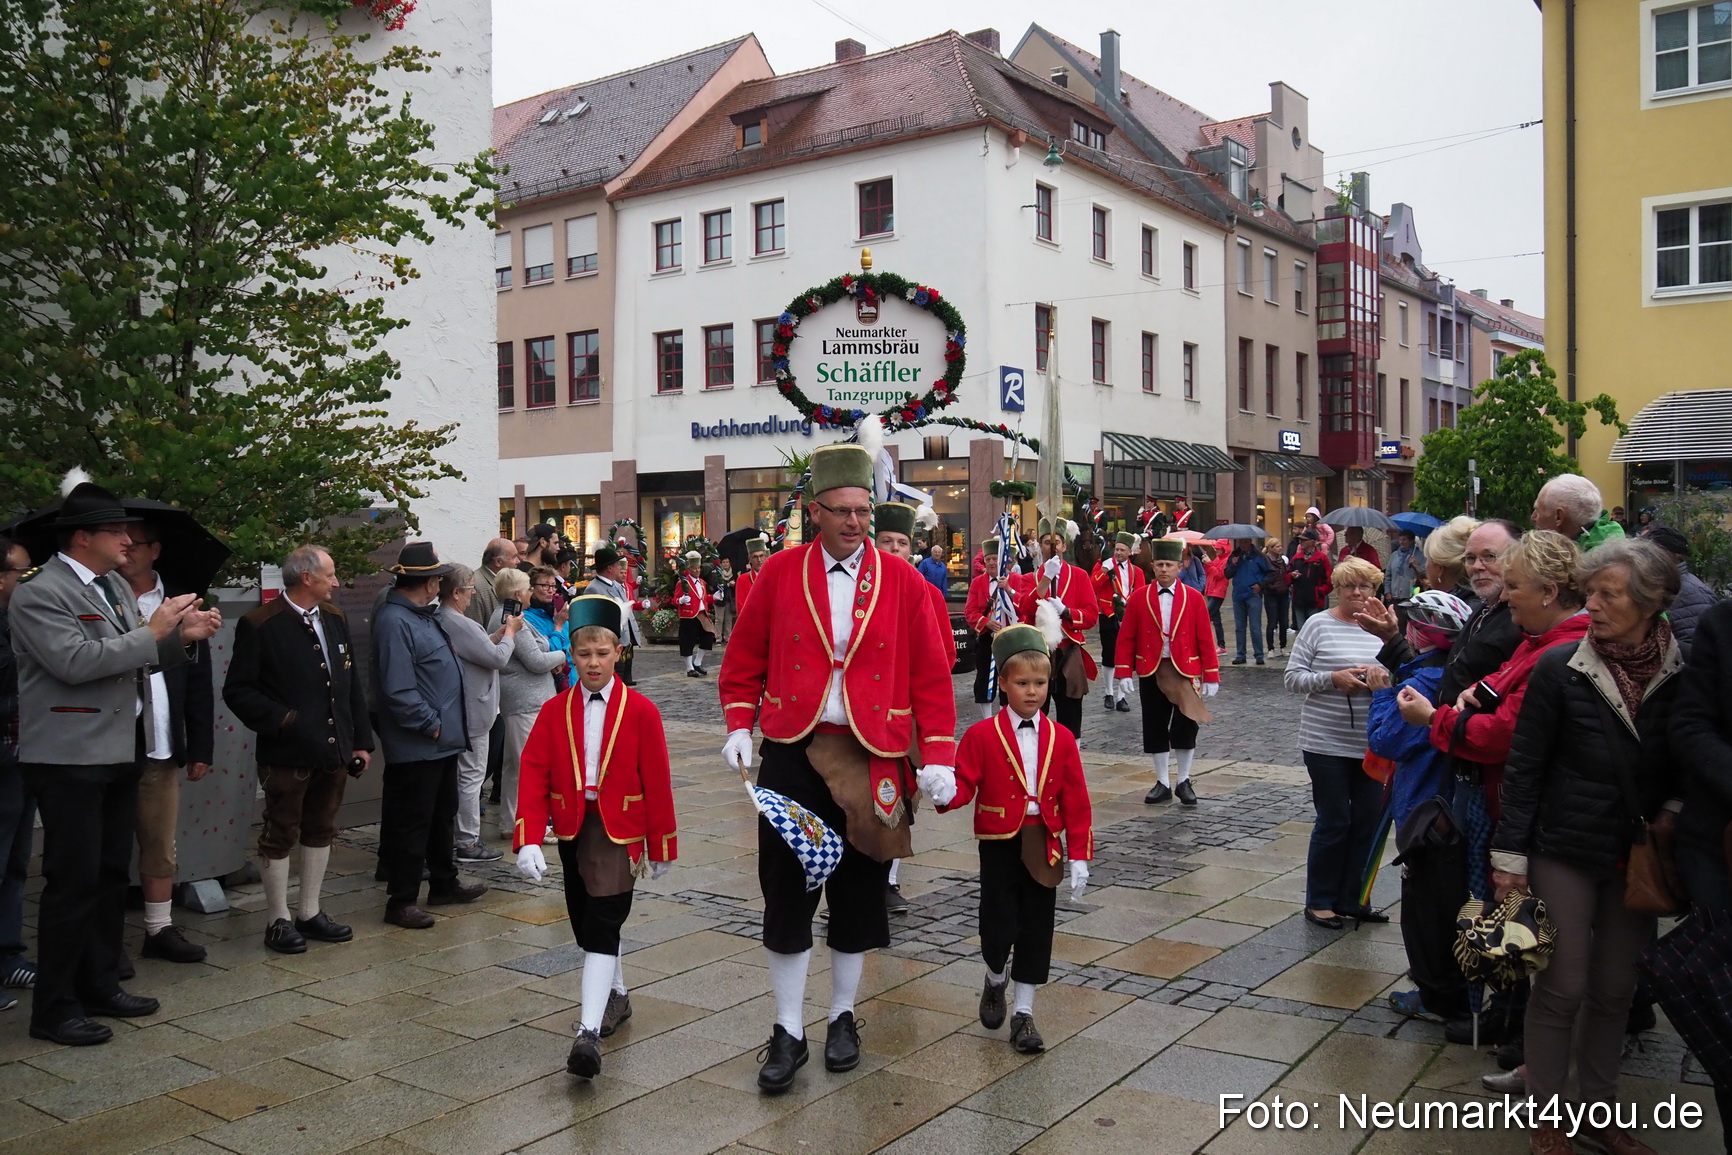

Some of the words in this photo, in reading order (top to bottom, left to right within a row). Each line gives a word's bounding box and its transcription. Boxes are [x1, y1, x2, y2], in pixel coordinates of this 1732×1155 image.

[835, 327, 907, 338] Neumarkter
[822, 339, 919, 355] Lammsbräu
[816, 360, 922, 383] Schäffler
[691, 414, 812, 438] Buchhandlung
[1283, 432, 1301, 446] CECIL
